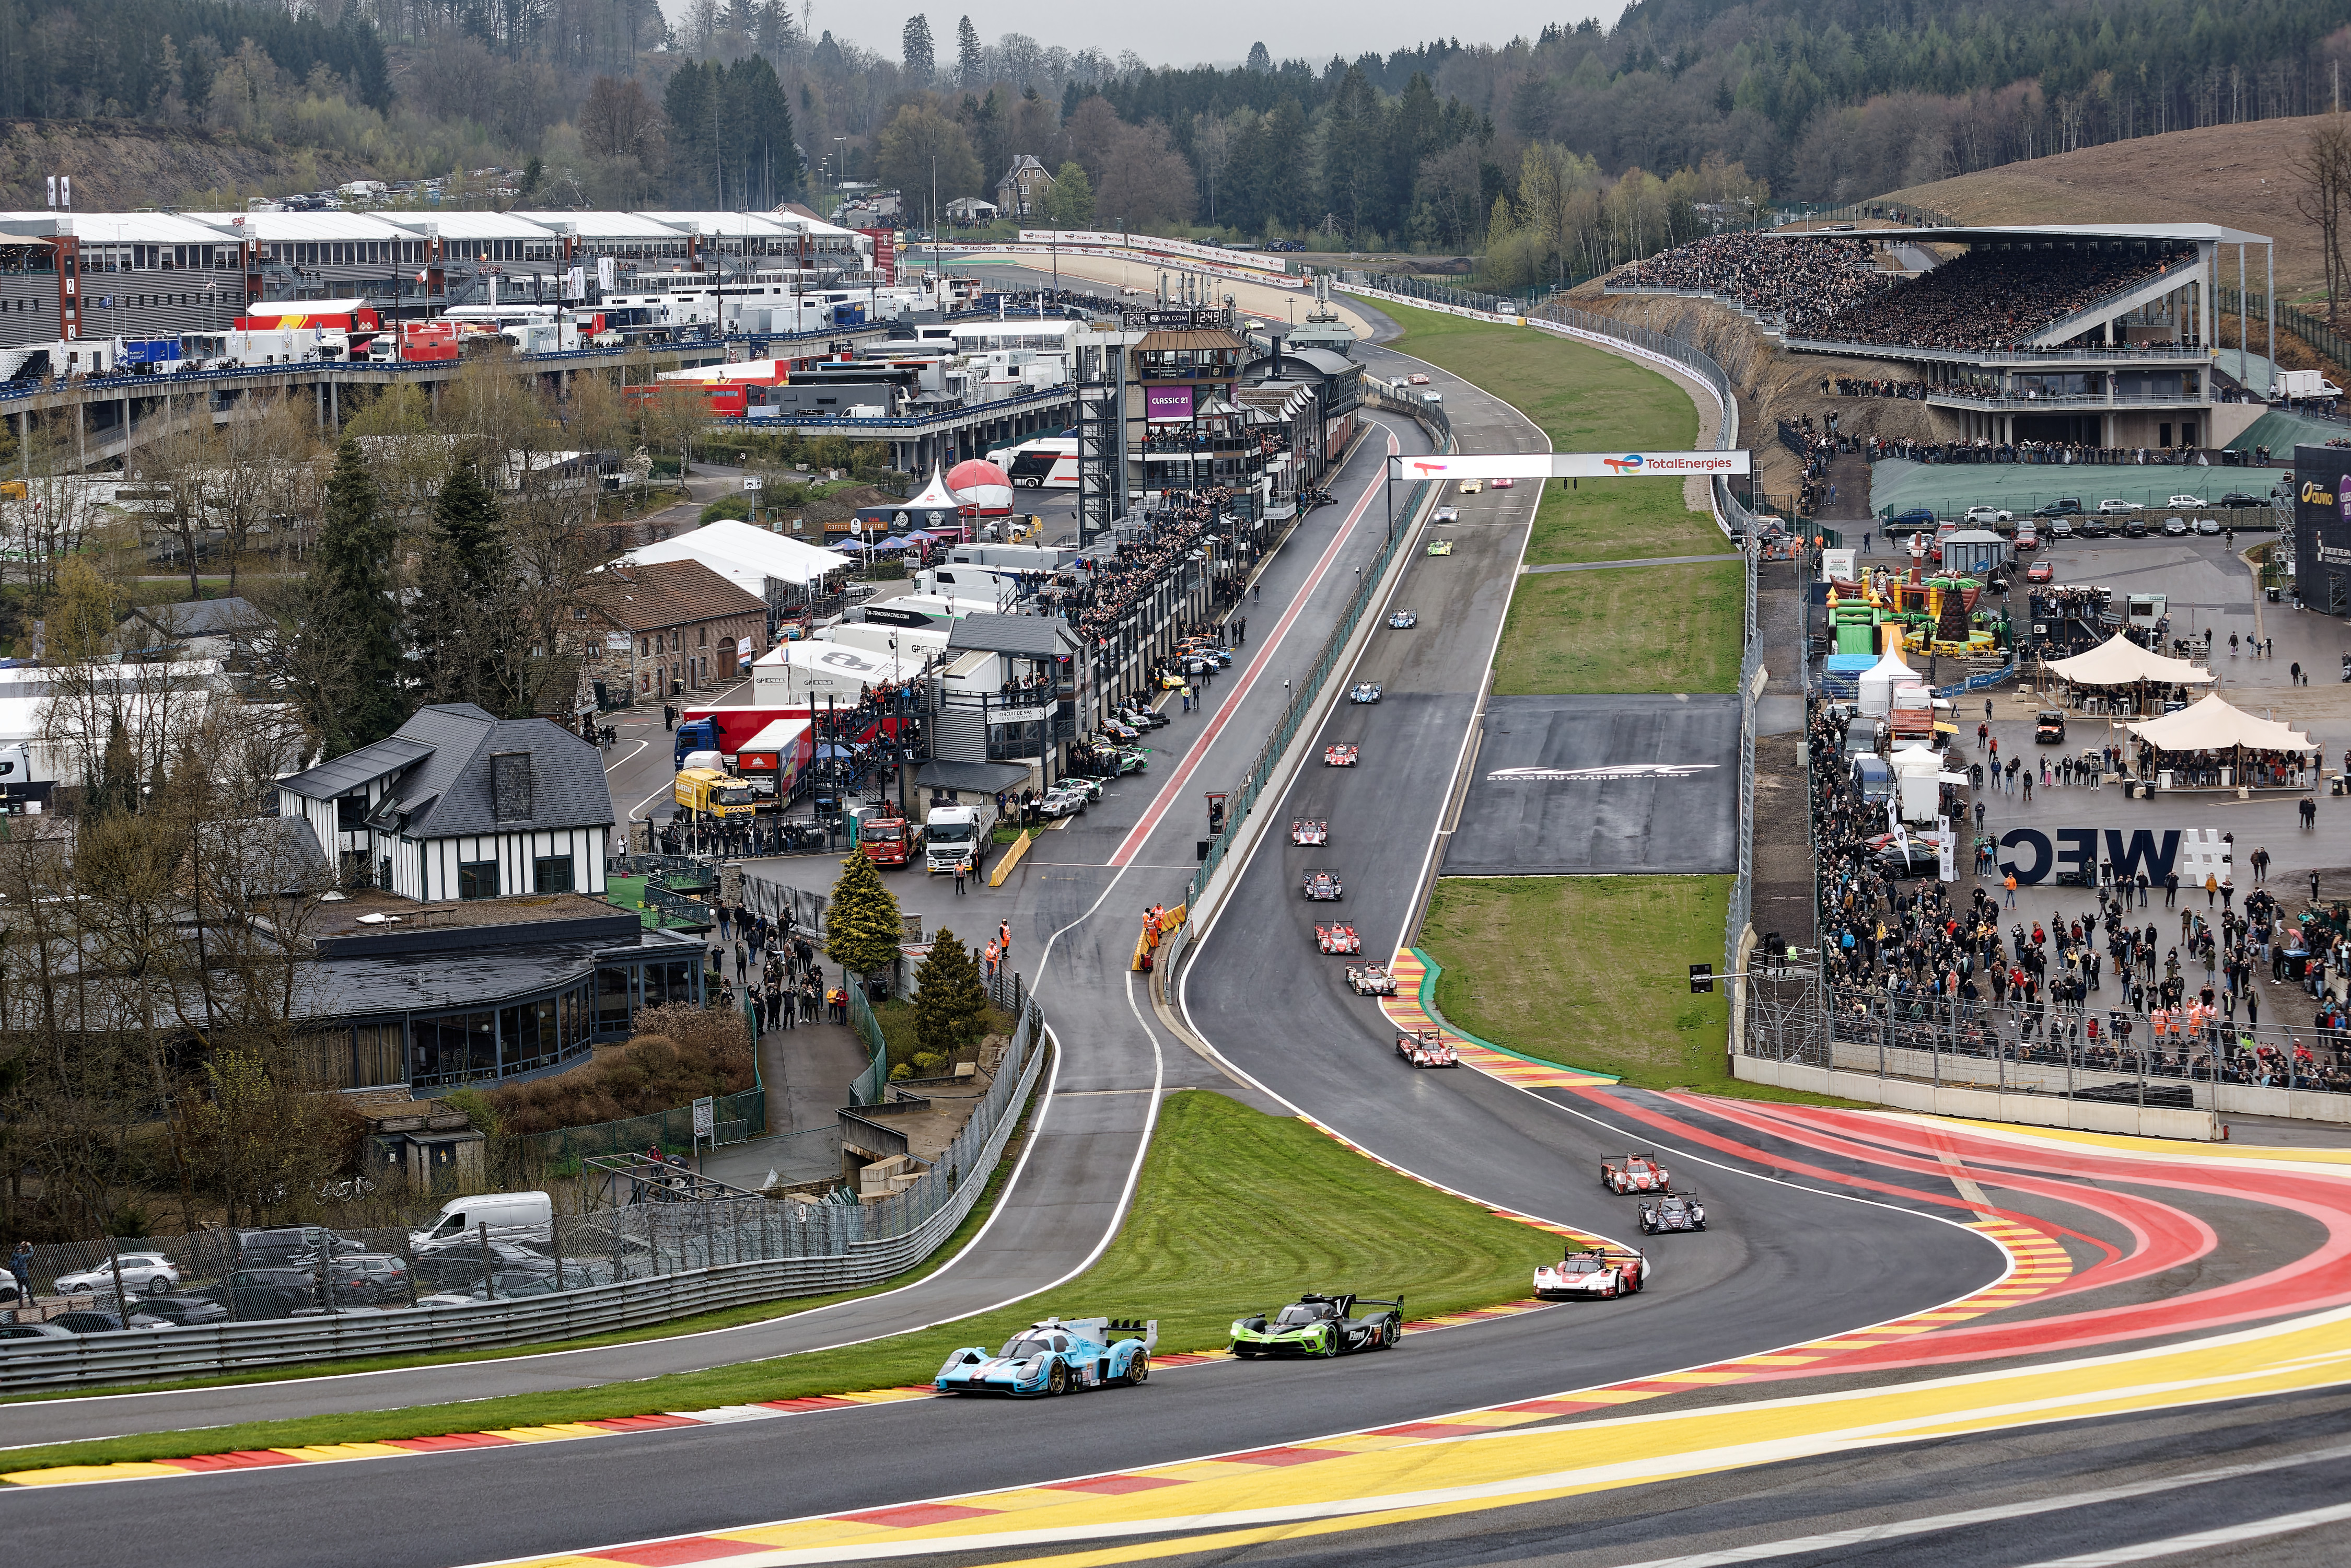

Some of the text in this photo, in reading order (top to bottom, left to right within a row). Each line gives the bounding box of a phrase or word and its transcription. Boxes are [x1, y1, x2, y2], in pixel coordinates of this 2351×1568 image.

[434, 238, 437, 247] 4
[573, 235, 576, 245] 5
[696, 234, 699, 242] 6
[806, 233, 809, 242] 7
[884, 236, 887, 245] 8
[251, 239, 254, 250] 3
[69, 281, 73, 292] 2
[1126, 313, 1145, 324] 12:49
[1196, 311, 1219, 323] 12:49
[69, 327, 74, 339] 2
[1646, 458, 1731, 471] TotalEnergies
[2344, 504, 2351, 515] 21
[912, 645, 921, 653] GP
[679, 784, 692, 793] METRAS
[1397, 1305, 1403, 1316] 4
[1348, 1329, 1365, 1340] Floyd
[1375, 1333, 1379, 1343] 4
